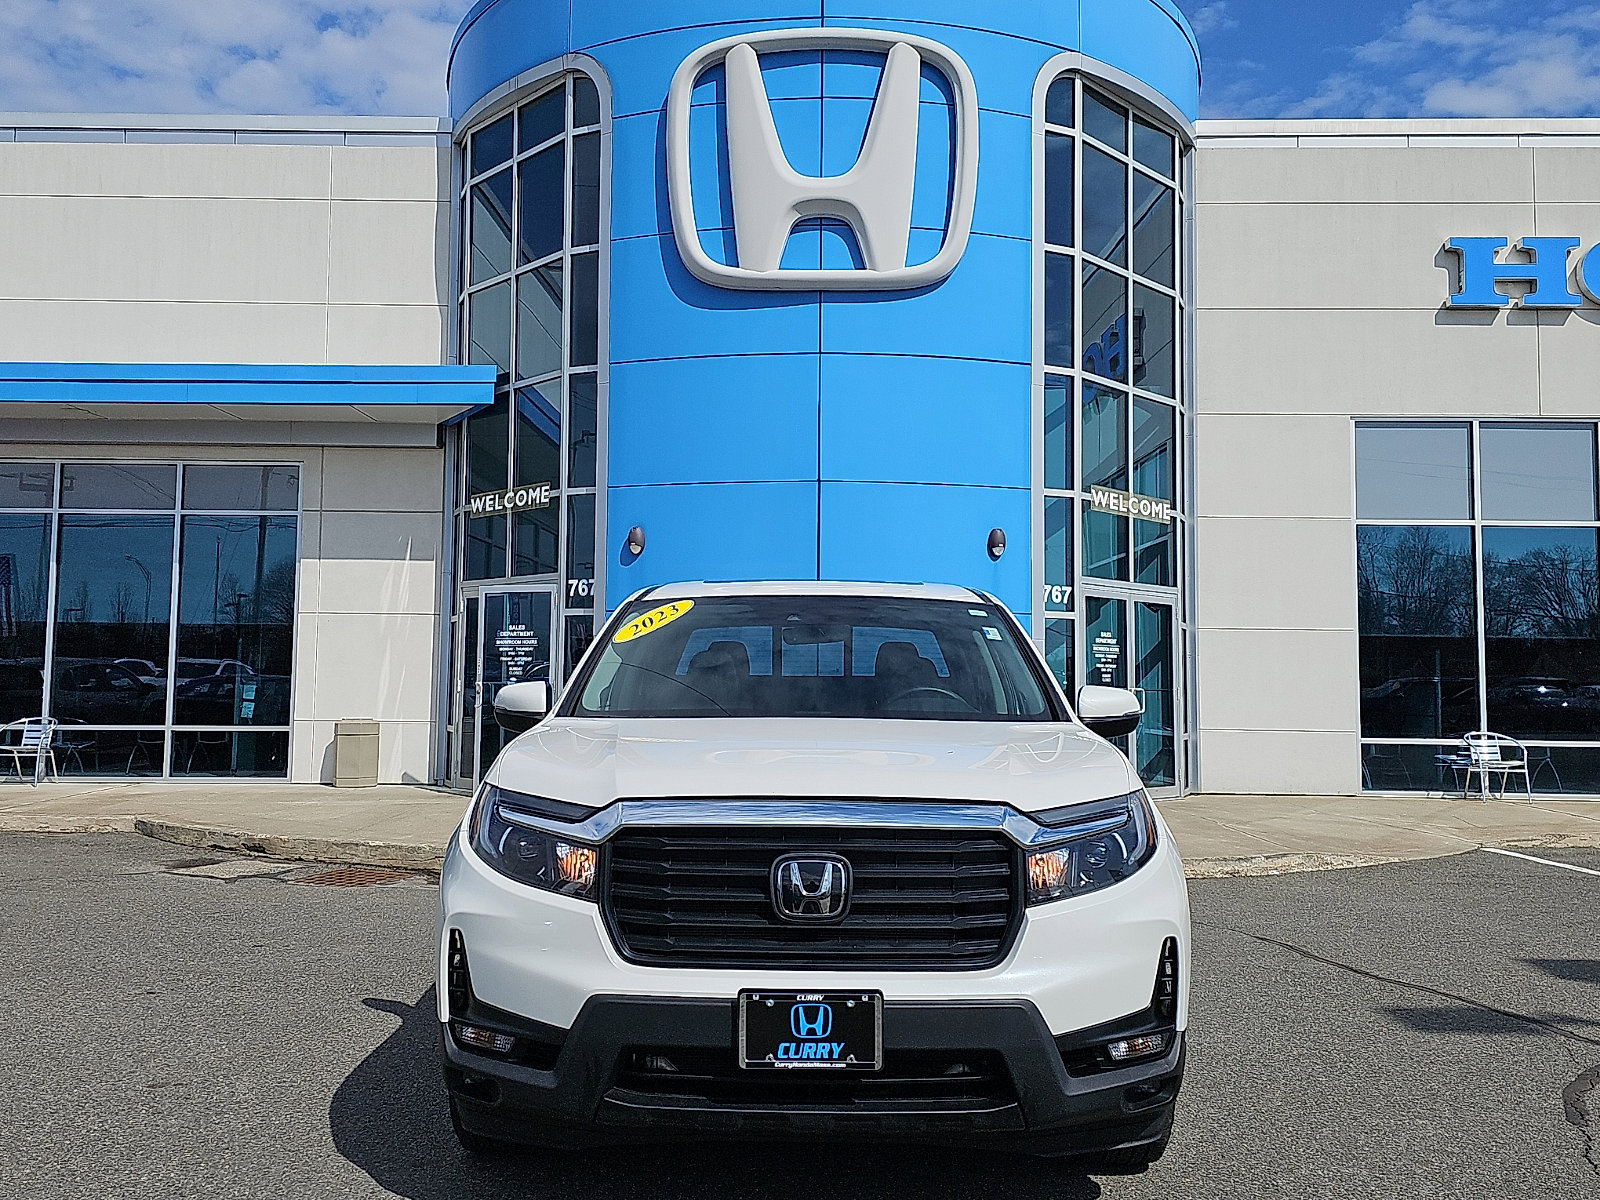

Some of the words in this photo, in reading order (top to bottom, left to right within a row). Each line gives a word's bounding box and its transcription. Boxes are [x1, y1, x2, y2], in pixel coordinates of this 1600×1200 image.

[1449, 237, 1600, 304] H
[471, 486, 549, 513] WELCOME
[1091, 489, 1170, 520] WELCOME
[1044, 585, 1072, 603] 767
[629, 604, 679, 636] 2023
[778, 1043, 845, 1059] CURRY
